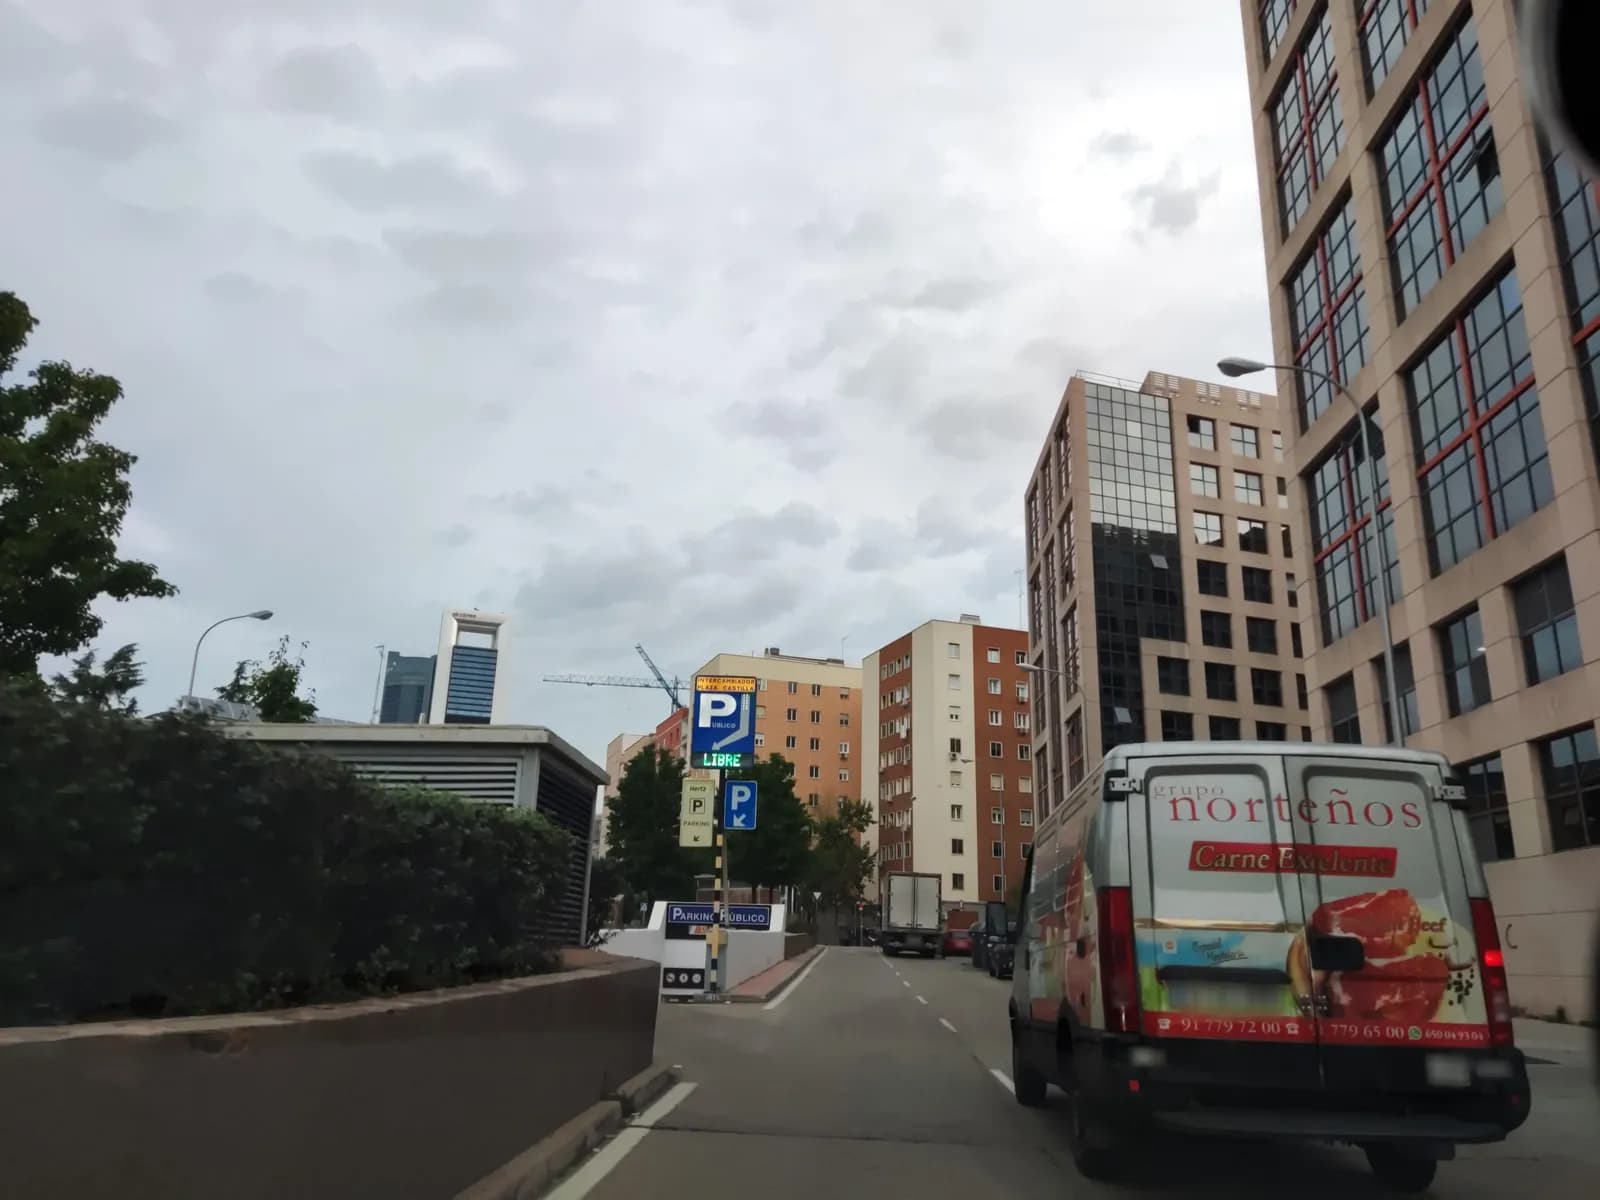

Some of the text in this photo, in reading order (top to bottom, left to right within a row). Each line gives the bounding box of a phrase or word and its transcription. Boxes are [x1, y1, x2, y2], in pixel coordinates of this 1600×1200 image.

[703, 753, 741, 767] LIBRE
[731, 785, 751, 811] P
[1153, 785, 1225, 801] grupo
[692, 799, 703, 813] P
[1168, 788, 1422, 829] norteños
[1195, 845, 1271, 869] Carne
[1181, 1018, 1199, 1031] 91
[1206, 1019, 1233, 1032] 779
[1239, 1020, 1257, 1033] 72
[1261, 1021, 1281, 1034] 00
[1331, 1024, 1359, 1038] 779
[1363, 1025, 1381, 1038] 65
[1386, 1026, 1404, 1039] 00
